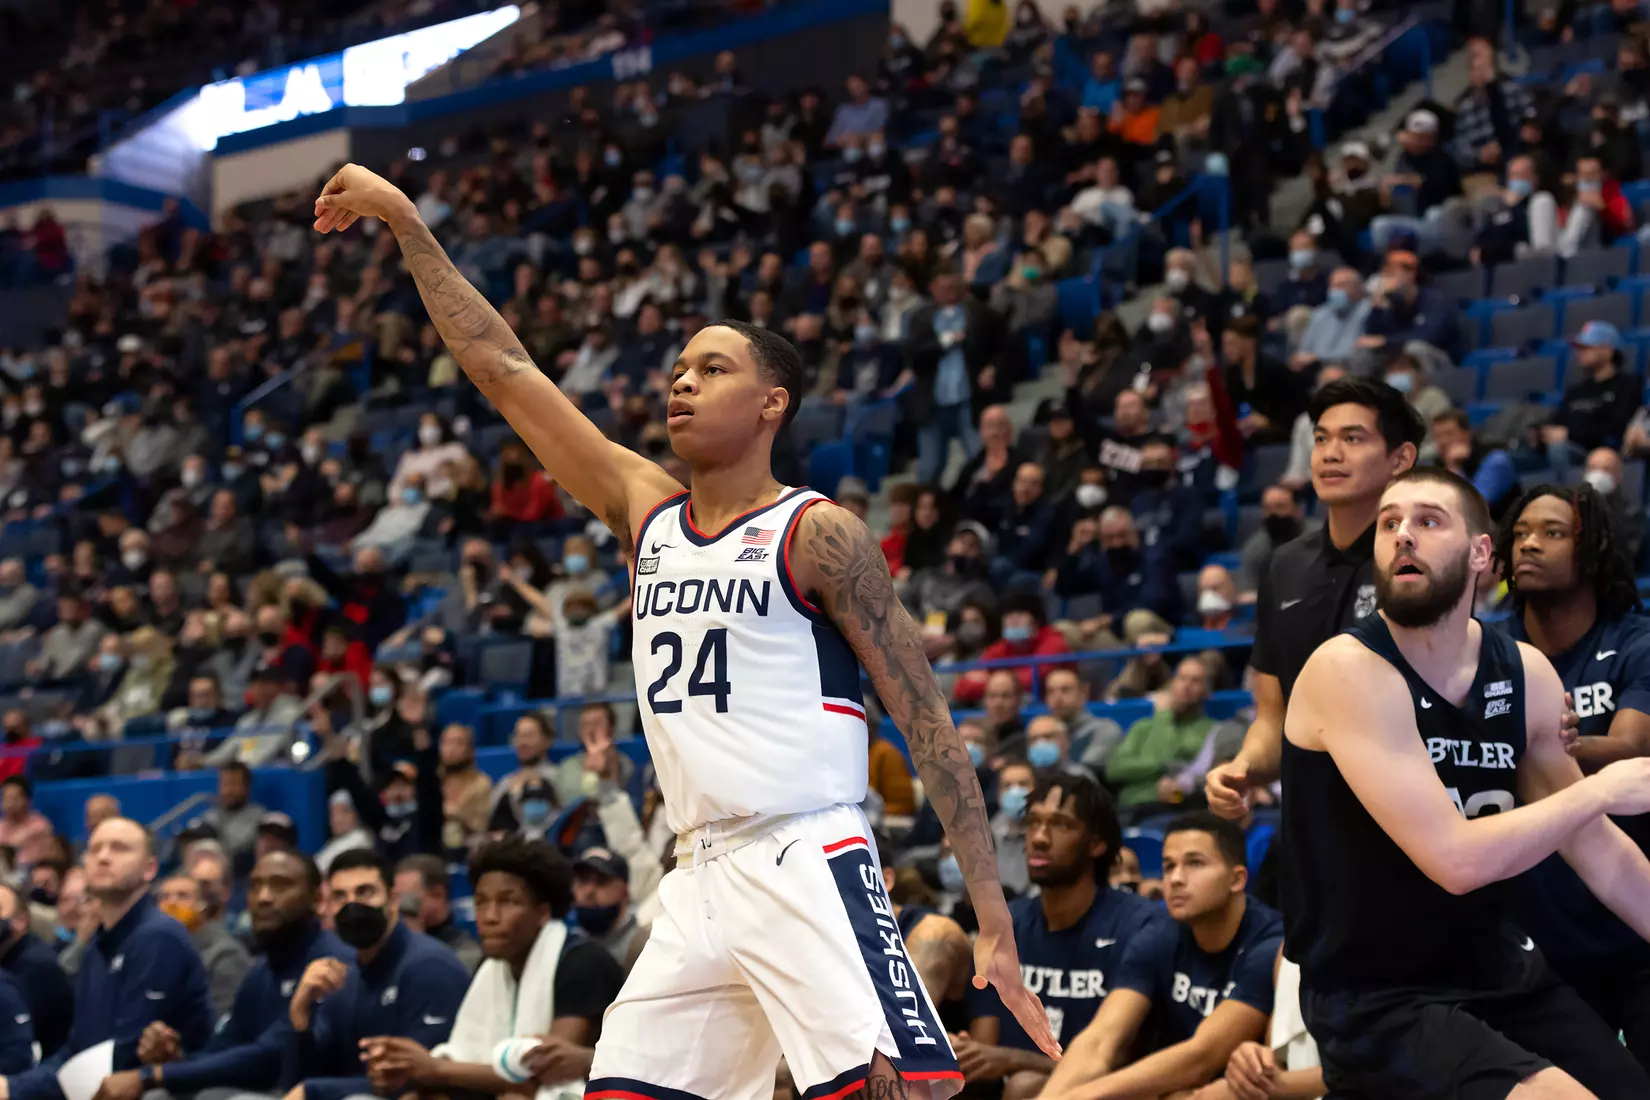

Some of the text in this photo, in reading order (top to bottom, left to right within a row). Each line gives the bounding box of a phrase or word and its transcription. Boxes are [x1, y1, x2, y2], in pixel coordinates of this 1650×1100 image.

[636, 578, 771, 620] UCONN
[647, 627, 731, 715] 24
[1572, 681, 1616, 718] ER
[1426, 737, 1517, 769] BTLER
[859, 863, 937, 1046] HUSKIES
[1019, 964, 1108, 998] UTLER
